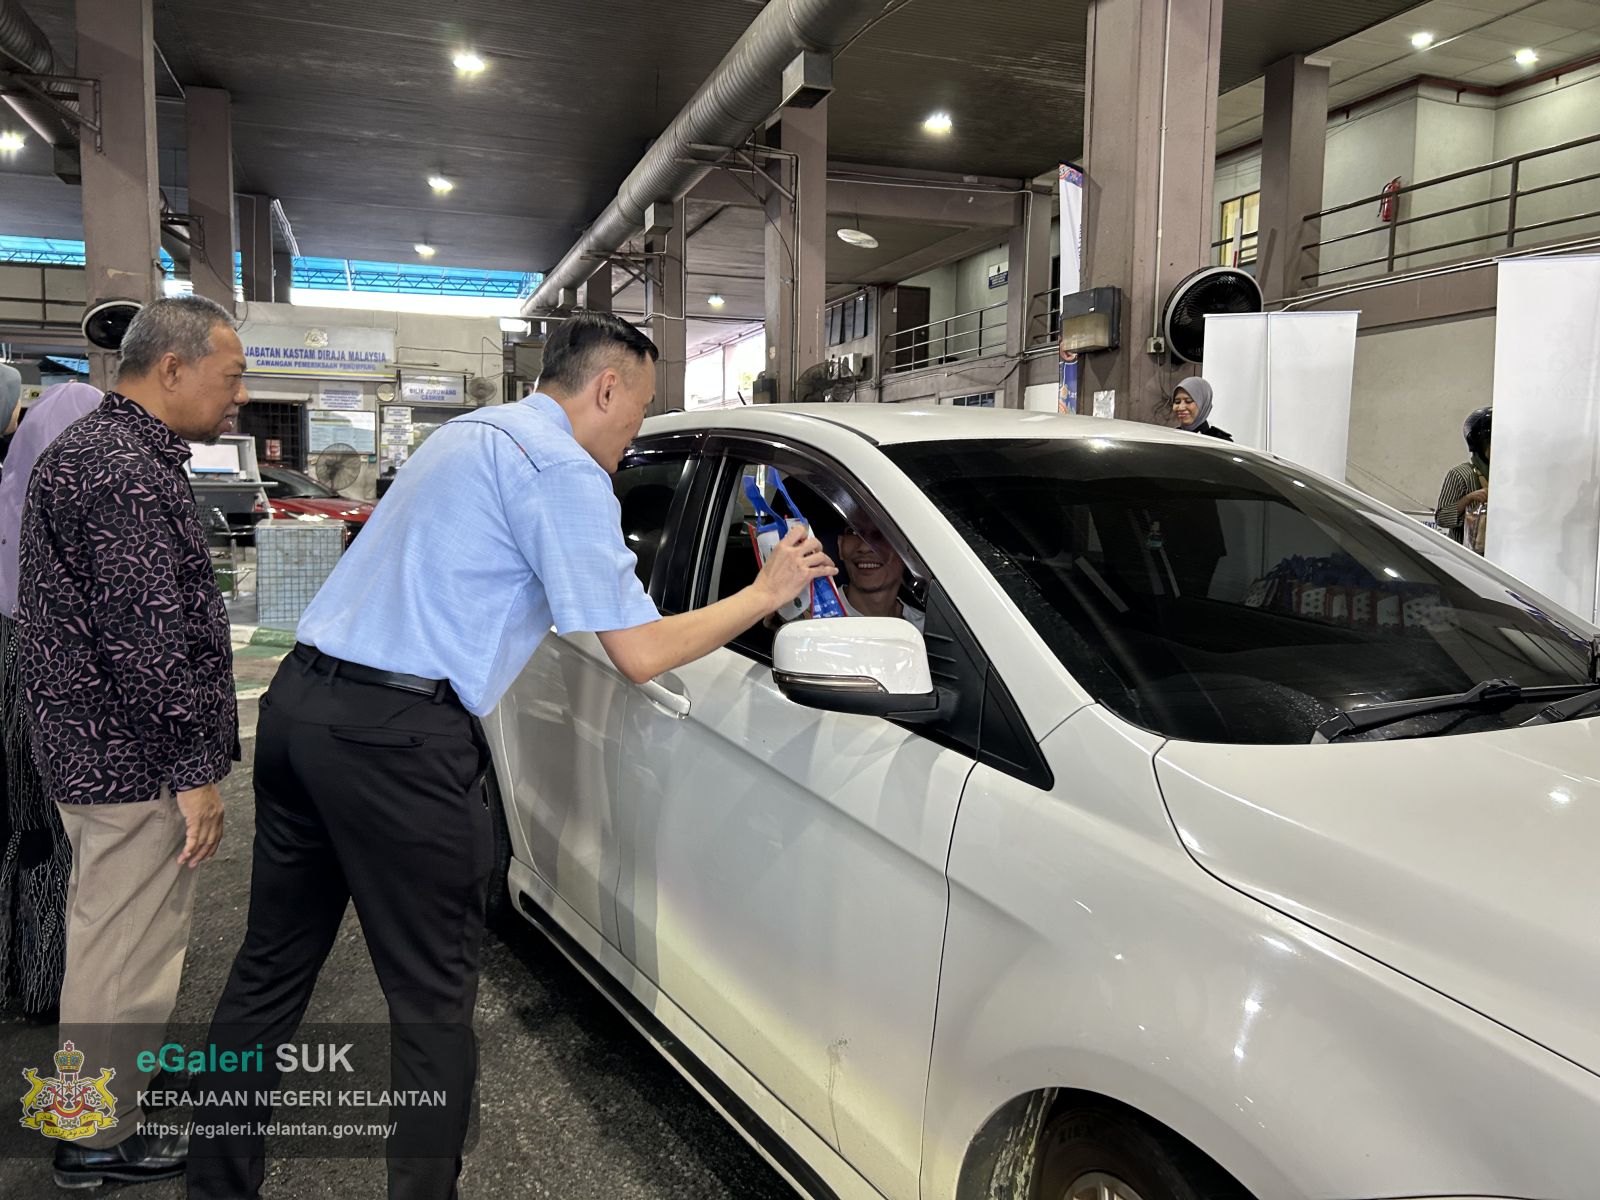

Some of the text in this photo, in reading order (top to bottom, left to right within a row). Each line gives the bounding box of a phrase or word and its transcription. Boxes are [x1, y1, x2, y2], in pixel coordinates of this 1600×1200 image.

[244, 346, 386, 362] JABATAN KASTAM DIRAJA MALAYSIA
[294, 361, 338, 369] PEMERIKSAAN
